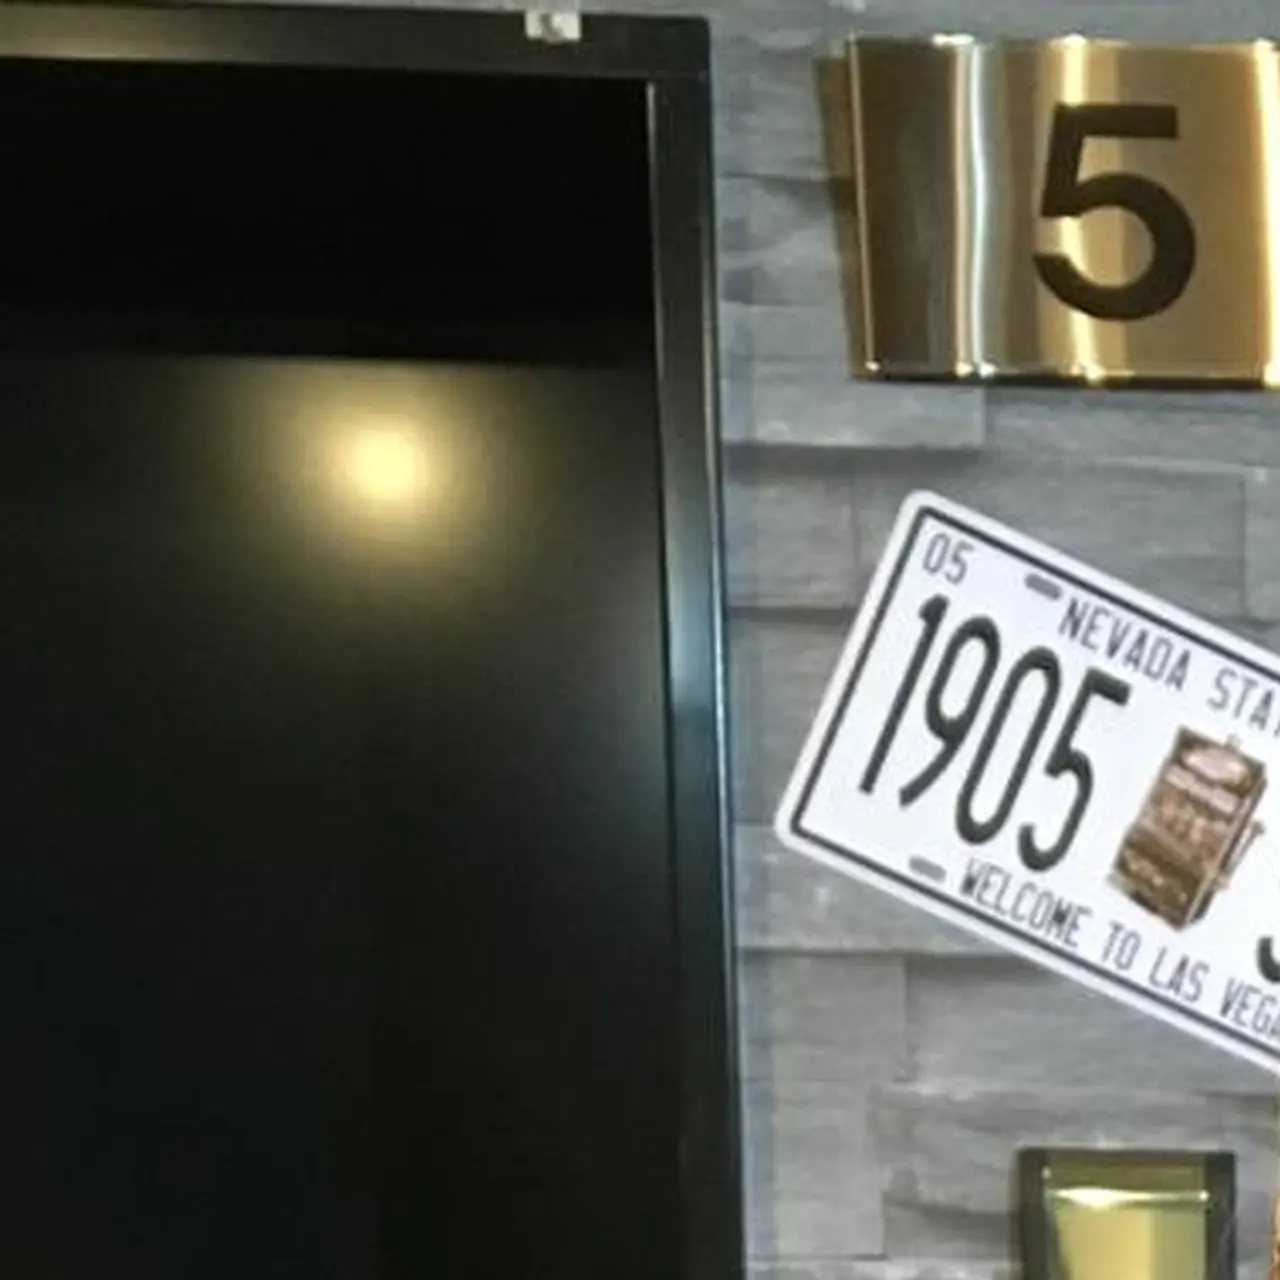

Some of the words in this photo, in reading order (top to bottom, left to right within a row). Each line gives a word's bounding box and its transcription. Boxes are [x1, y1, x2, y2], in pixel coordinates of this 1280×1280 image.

[1033, 104, 1197, 322] 5
[923, 534, 973, 584] 05
[1057, 598, 1195, 692] NEVADA
[859, 595, 1131, 871] 1905
[959, 857, 1093, 953] WELCOME
[1103, 922, 1141, 971] TO
[1149, 946, 1209, 1003] LAS
